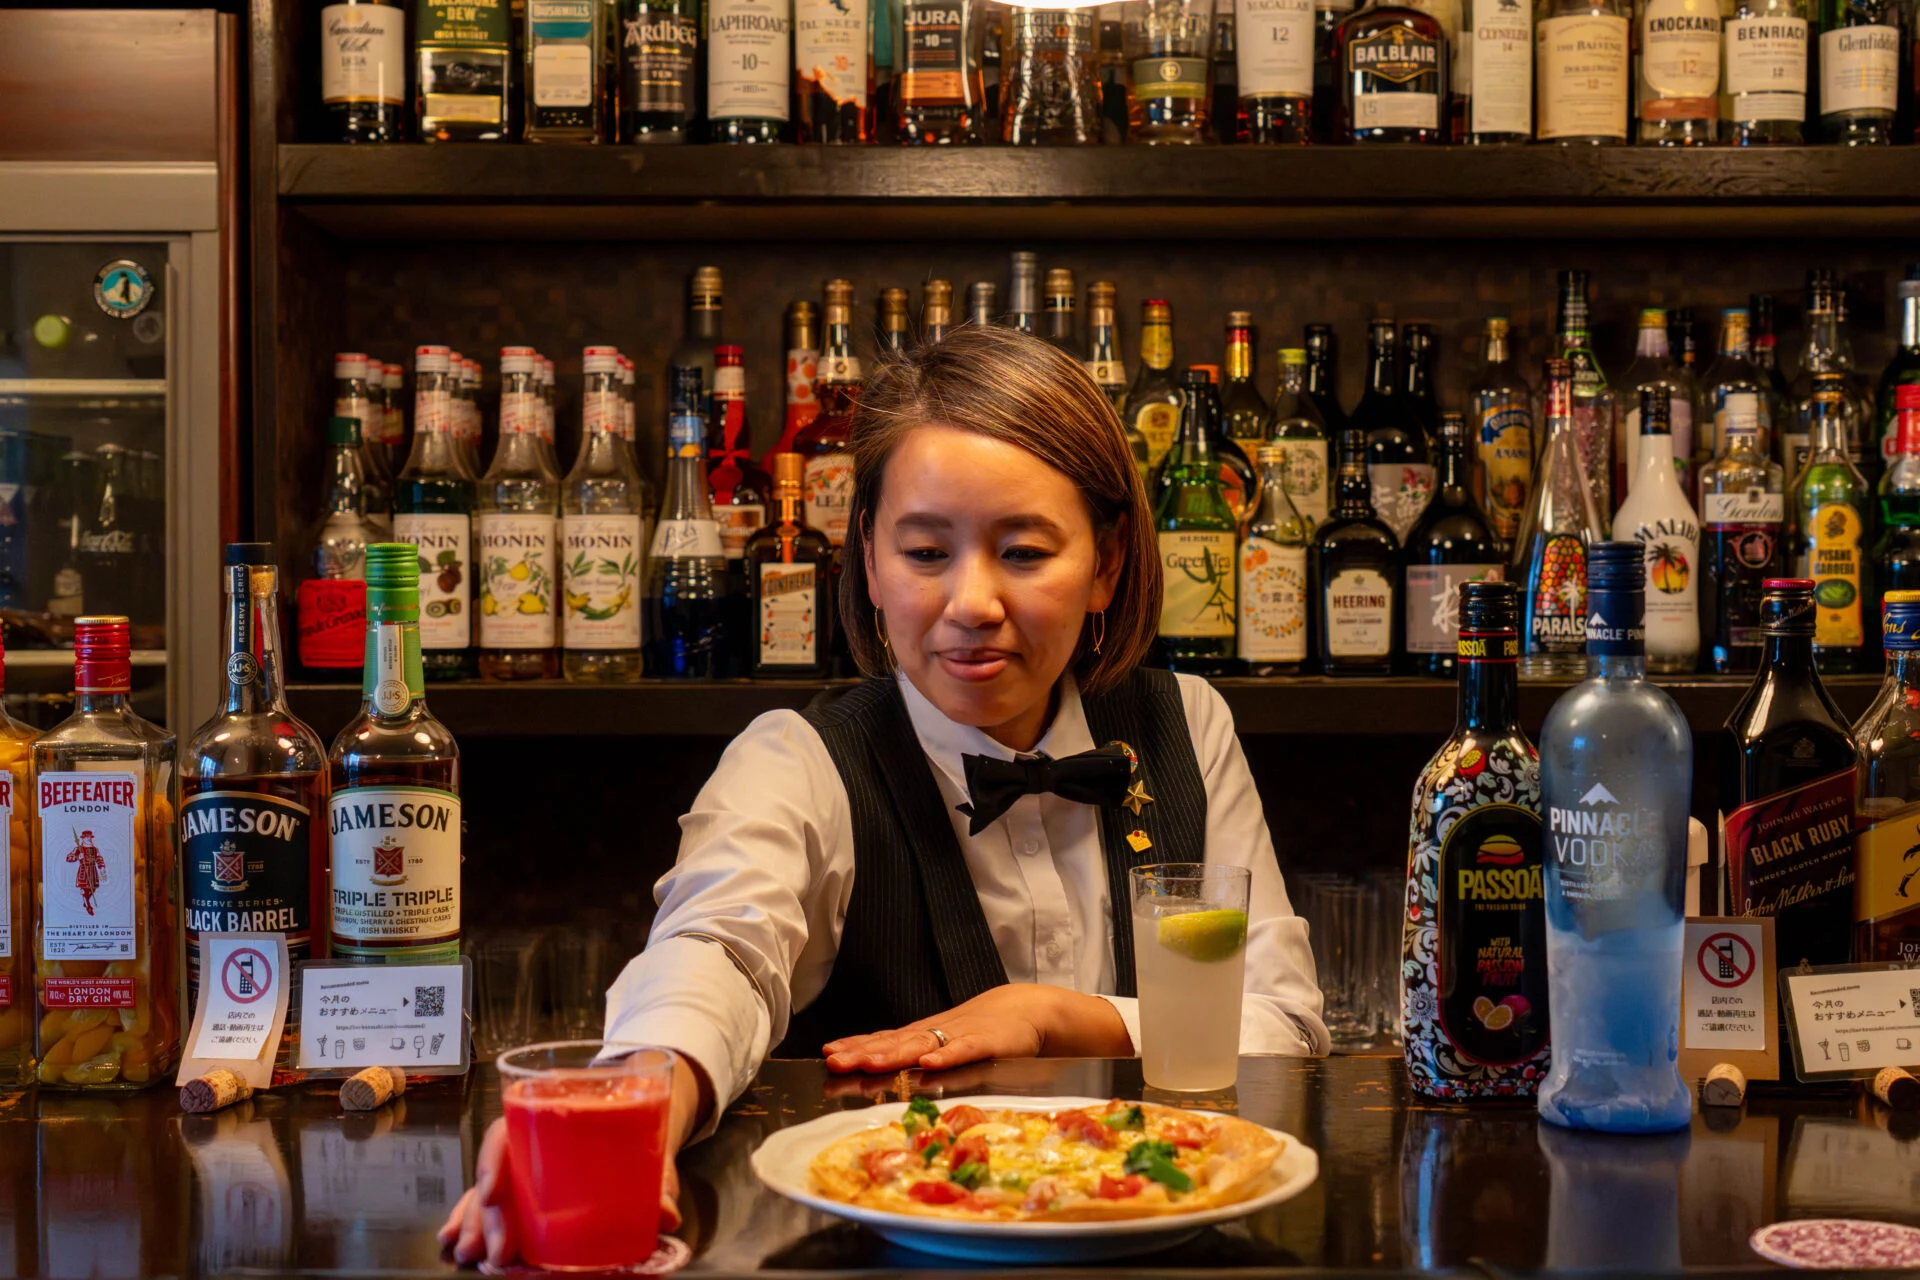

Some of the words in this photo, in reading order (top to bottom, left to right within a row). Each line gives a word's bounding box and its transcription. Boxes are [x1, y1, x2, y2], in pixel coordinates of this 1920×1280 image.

[904, 10, 962, 24] JURA
[1272, 27, 1290, 41] 12
[1355, 45, 1436, 63] BALBLAIR
[742, 53, 758, 70] 10
[482, 534, 546, 548] MONIN
[567, 535, 633, 548] MONIN
[1333, 594, 1386, 609] HEERING
[238, 602, 246, 643] RESERVE
[41, 781, 135, 809] BEEFEATER
[64, 805, 110, 813] LONDON
[181, 807, 297, 844] JAMESON
[331, 803, 450, 836] JAMESON
[1750, 832, 1805, 867] BLACK
[1808, 814, 1851, 847] RUBY
[1458, 863, 1544, 900] PASSOÃ
[333, 889, 387, 907] TRIPLE
[392, 887, 454, 907] TRIPLE
[185, 907, 222, 932] BLACK
[227, 907, 299, 932] BARREL
[354, 909, 394, 917] DISTILLED
[403, 908, 430, 917] TRIPLE
[358, 926, 380, 935] IRISH
[381, 926, 420, 935] WHISKEY
[68, 987, 111, 995] LONDON
[319, 995, 350, 1005] 今月の
[1812, 1000, 1844, 1009] 今月の
[319, 1007, 398, 1017] おすすめメニュー
[1814, 1010, 1897, 1021] おすすめメニュー
